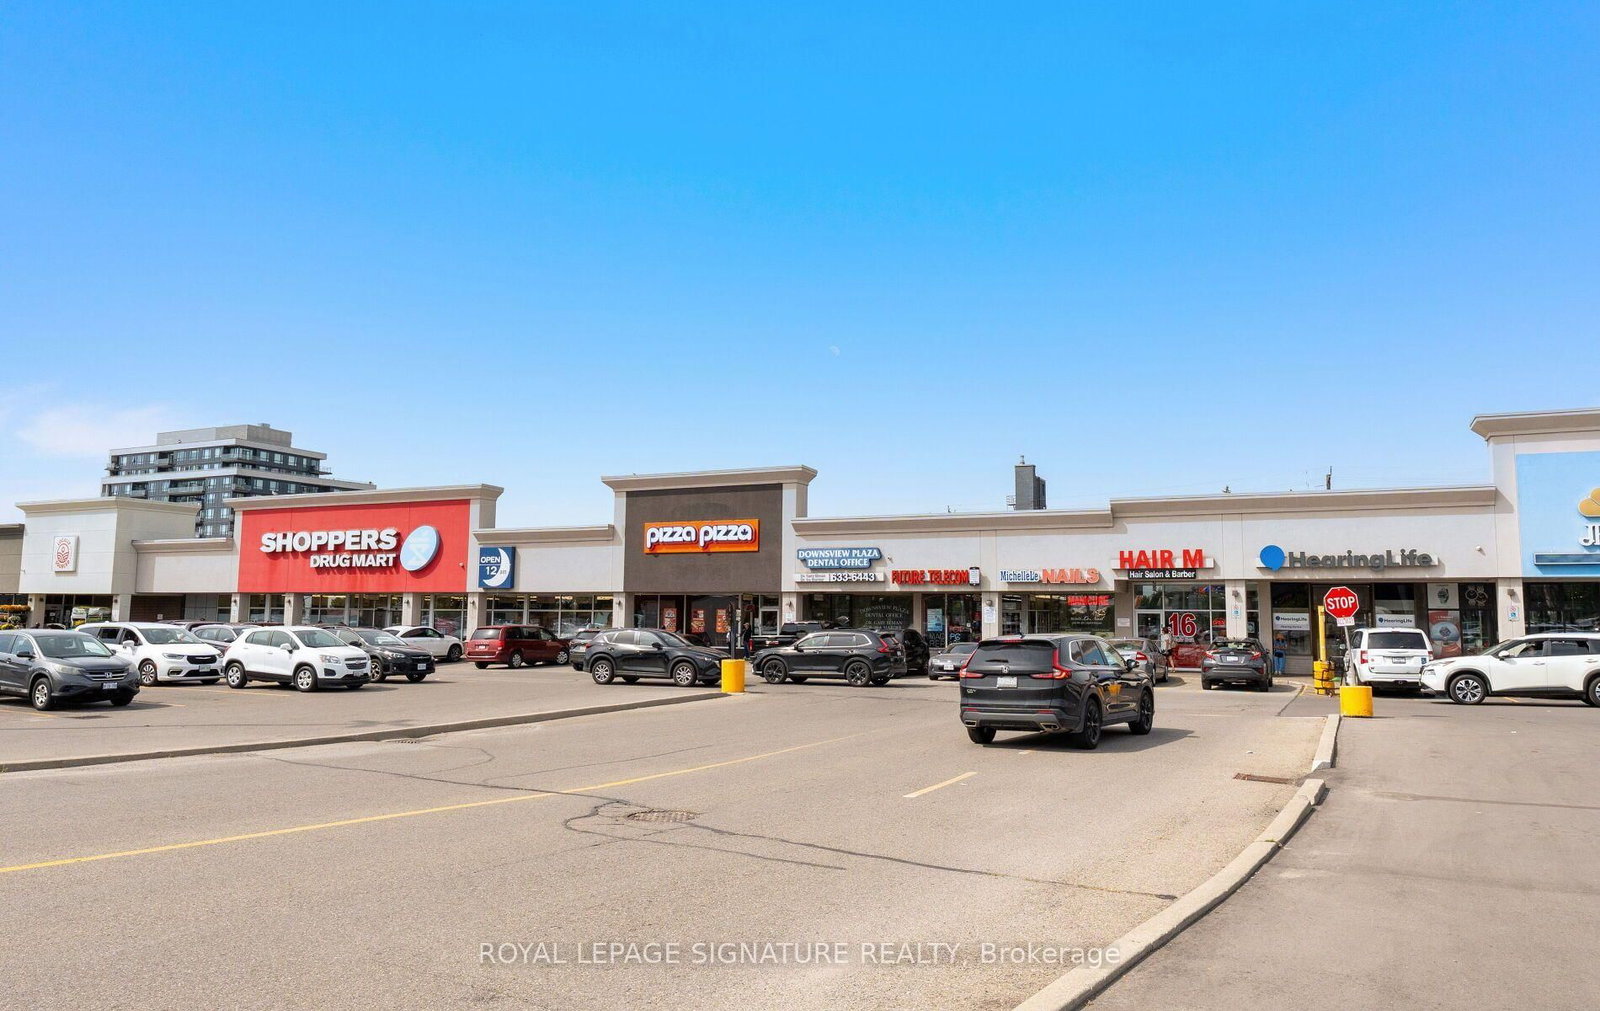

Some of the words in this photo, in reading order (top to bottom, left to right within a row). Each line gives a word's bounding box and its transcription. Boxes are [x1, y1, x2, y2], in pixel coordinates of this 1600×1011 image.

[260, 528, 398, 552] SHOPPERS
[646, 526, 696, 548] pizza
[700, 525, 752, 547] pizza
[310, 553, 350, 568] DRUG
[352, 553, 396, 567] MART
[798, 550, 850, 558] DOWNSVIEW
[852, 549, 879, 558] PLAZA
[1119, 549, 1175, 568] HAIR
[1182, 549, 1204, 568] M
[1288, 549, 1432, 571] HearingLife
[486, 566, 497, 575] 12
[808, 559, 839, 567] DENTAL
[840, 559, 869, 567] OFFICE
[831, 573, 876, 582] 633-6443
[892, 570, 926, 584] FUTURE
[928, 570, 969, 585] TELECOM
[1042, 568, 1099, 583] NAILS
[1145, 570, 1164, 578] Salon
[1171, 570, 1195, 578] Barber
[1327, 597, 1355, 609] STOP
